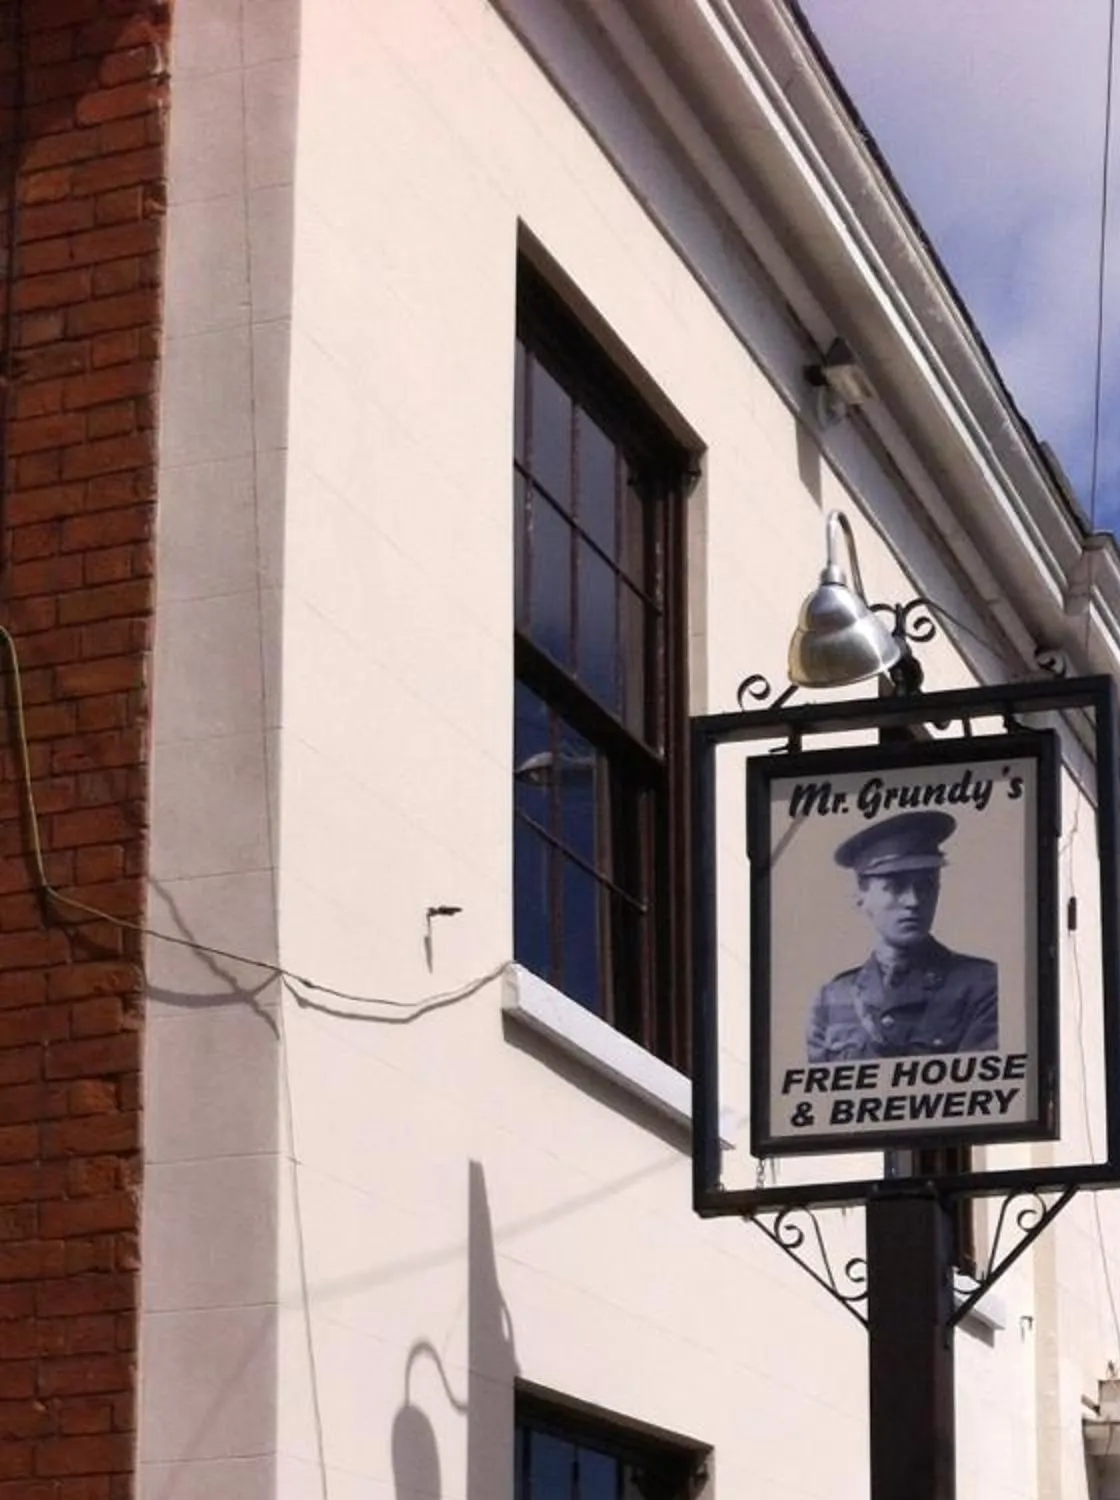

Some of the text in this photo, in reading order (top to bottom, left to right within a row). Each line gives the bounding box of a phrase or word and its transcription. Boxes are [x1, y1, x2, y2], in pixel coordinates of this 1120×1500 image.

[789, 766, 1023, 819] Mr. Grundy's
[782, 1054, 1027, 1094] FREE HOUSE
[790, 1088, 1019, 1127] & BREWERY
